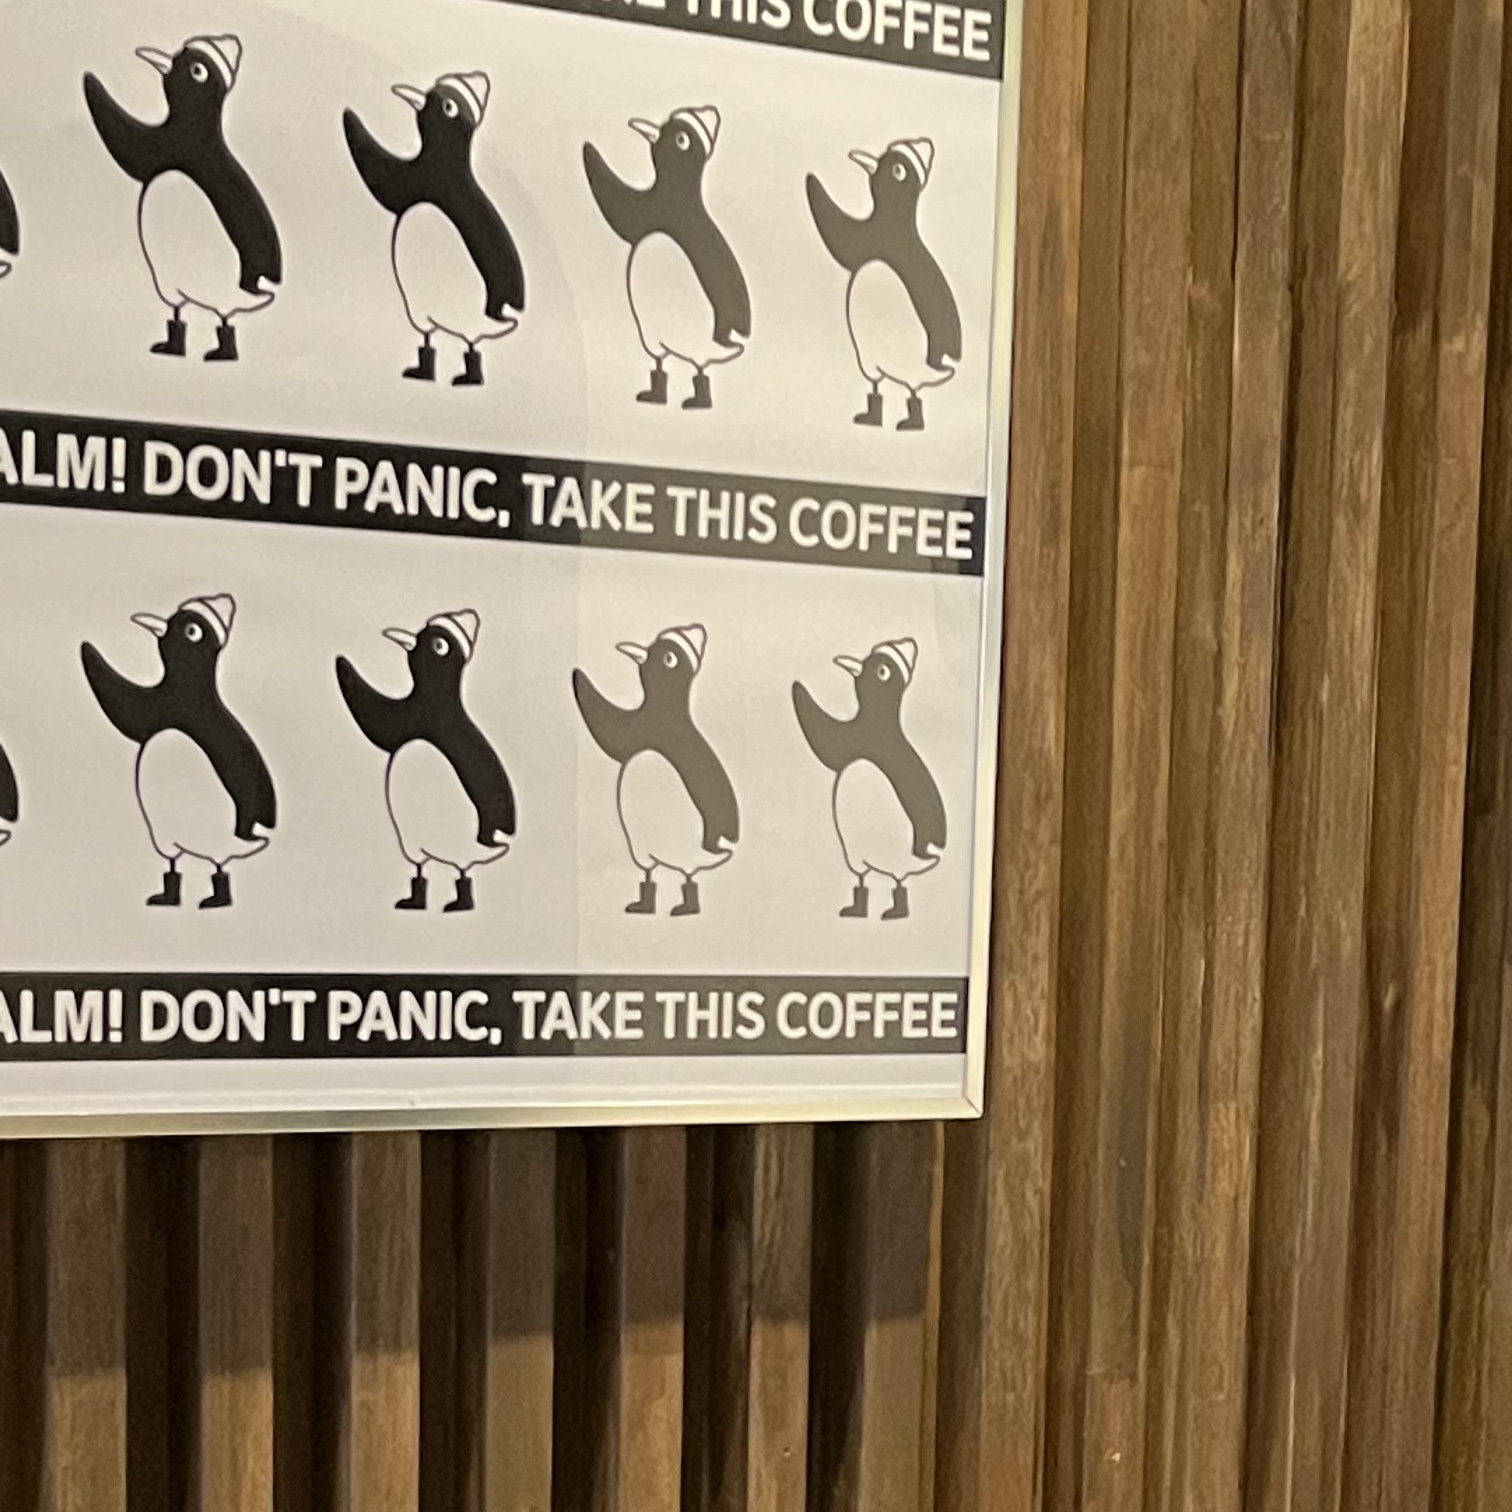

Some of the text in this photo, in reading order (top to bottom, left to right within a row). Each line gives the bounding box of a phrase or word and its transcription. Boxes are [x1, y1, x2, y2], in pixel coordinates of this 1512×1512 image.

[803, 0, 992, 62] COFFEE
[144, 440, 323, 508] DON'T
[335, 456, 510, 528] PANIC,
[522, 473, 656, 534] TAKE
[666, 485, 777, 544] THIS
[789, 498, 974, 560] COFFEE
[140, 988, 316, 1043] DON'T
[328, 990, 502, 1046] PANIC,
[512, 990, 644, 1040] TAKE
[655, 990, 766, 1040] THIS
[777, 991, 958, 1039] COFFEE
